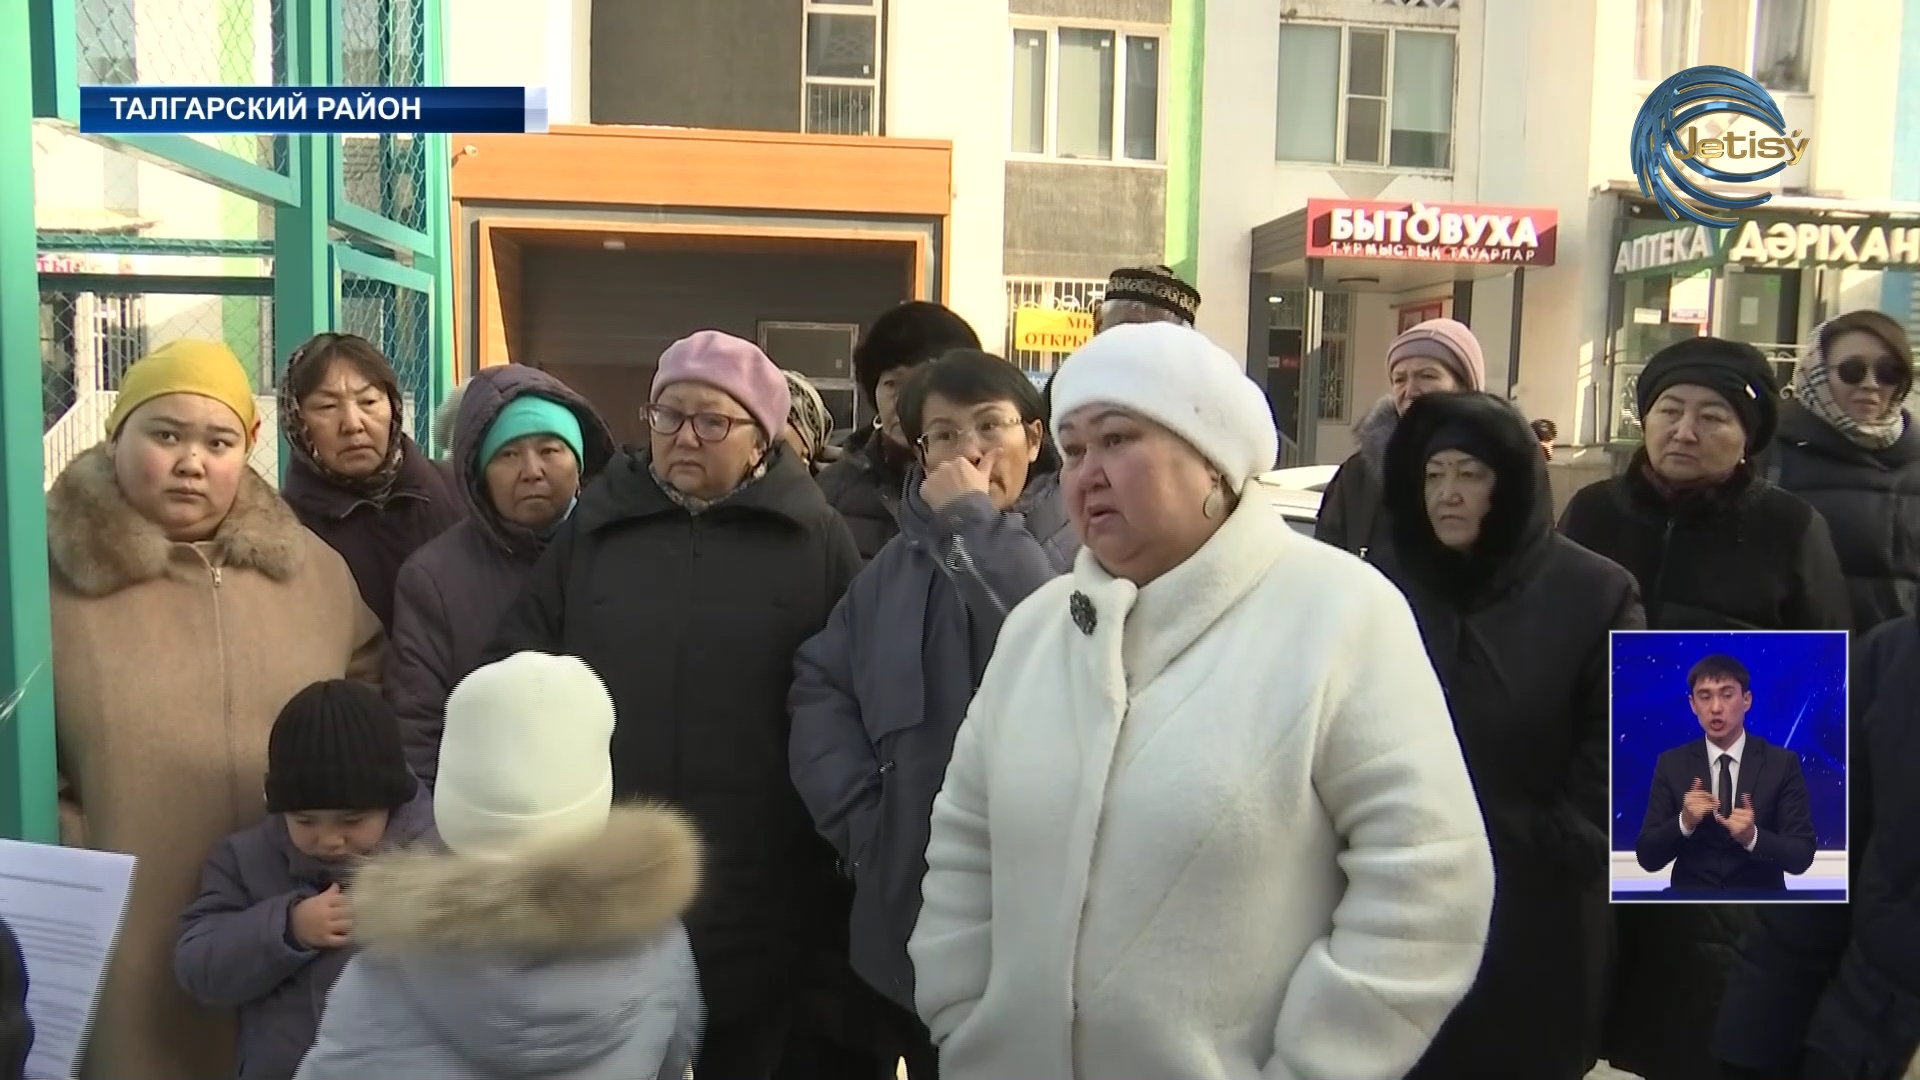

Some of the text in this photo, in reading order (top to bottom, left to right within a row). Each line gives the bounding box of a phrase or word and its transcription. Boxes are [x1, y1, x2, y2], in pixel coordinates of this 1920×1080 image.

[1330, 202, 1539, 248] БЫТОВУХА
[1449, 247, 1536, 262] ТАУАРЛАР
[1614, 223, 1714, 274] АПТЕКА
